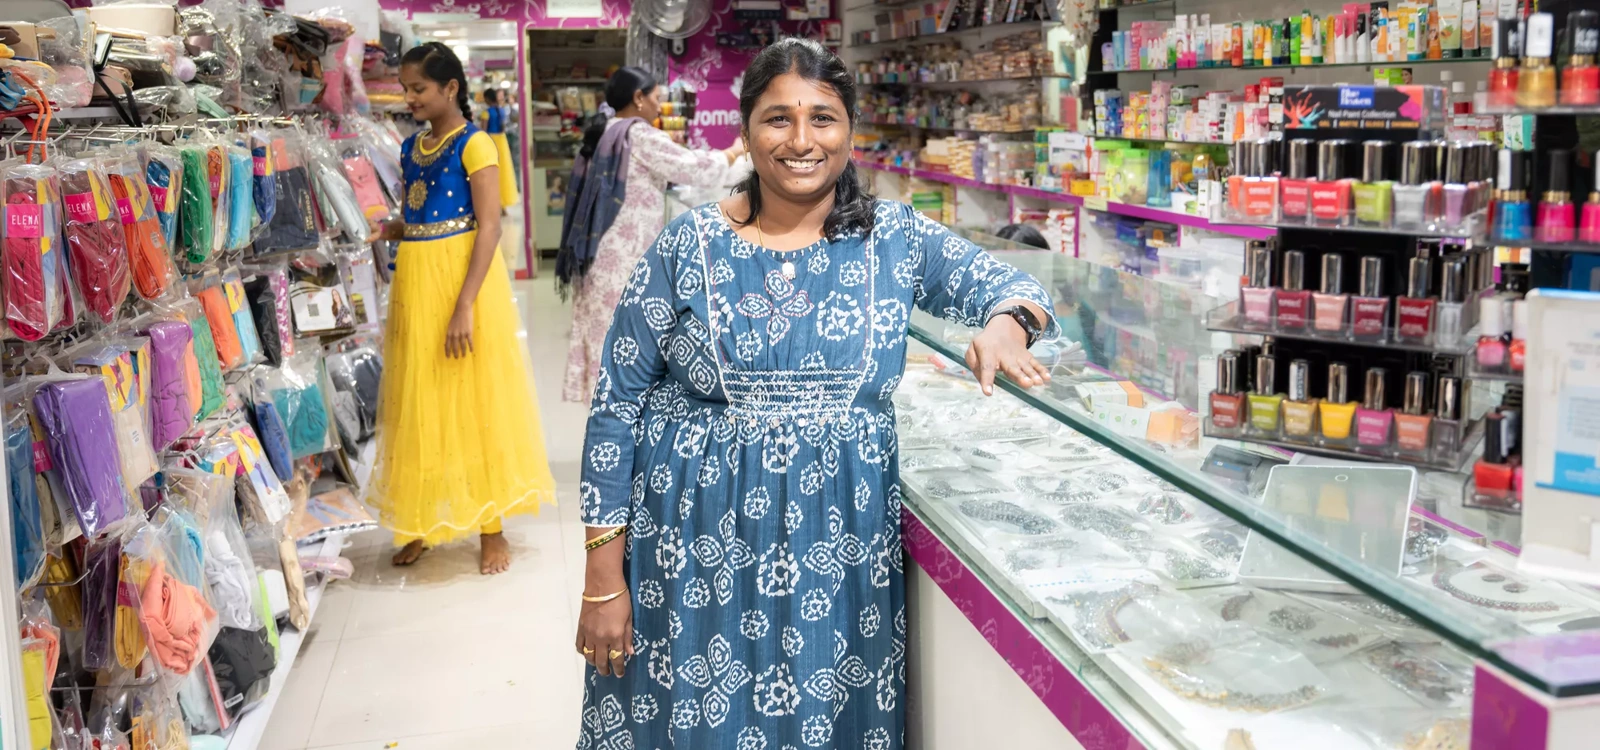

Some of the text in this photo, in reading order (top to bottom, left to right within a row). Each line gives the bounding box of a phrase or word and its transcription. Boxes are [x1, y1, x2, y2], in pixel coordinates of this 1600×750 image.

[687, 108, 743, 127] wome
[67, 201, 92, 213] ELENA
[11, 214, 39, 226] ELENA
